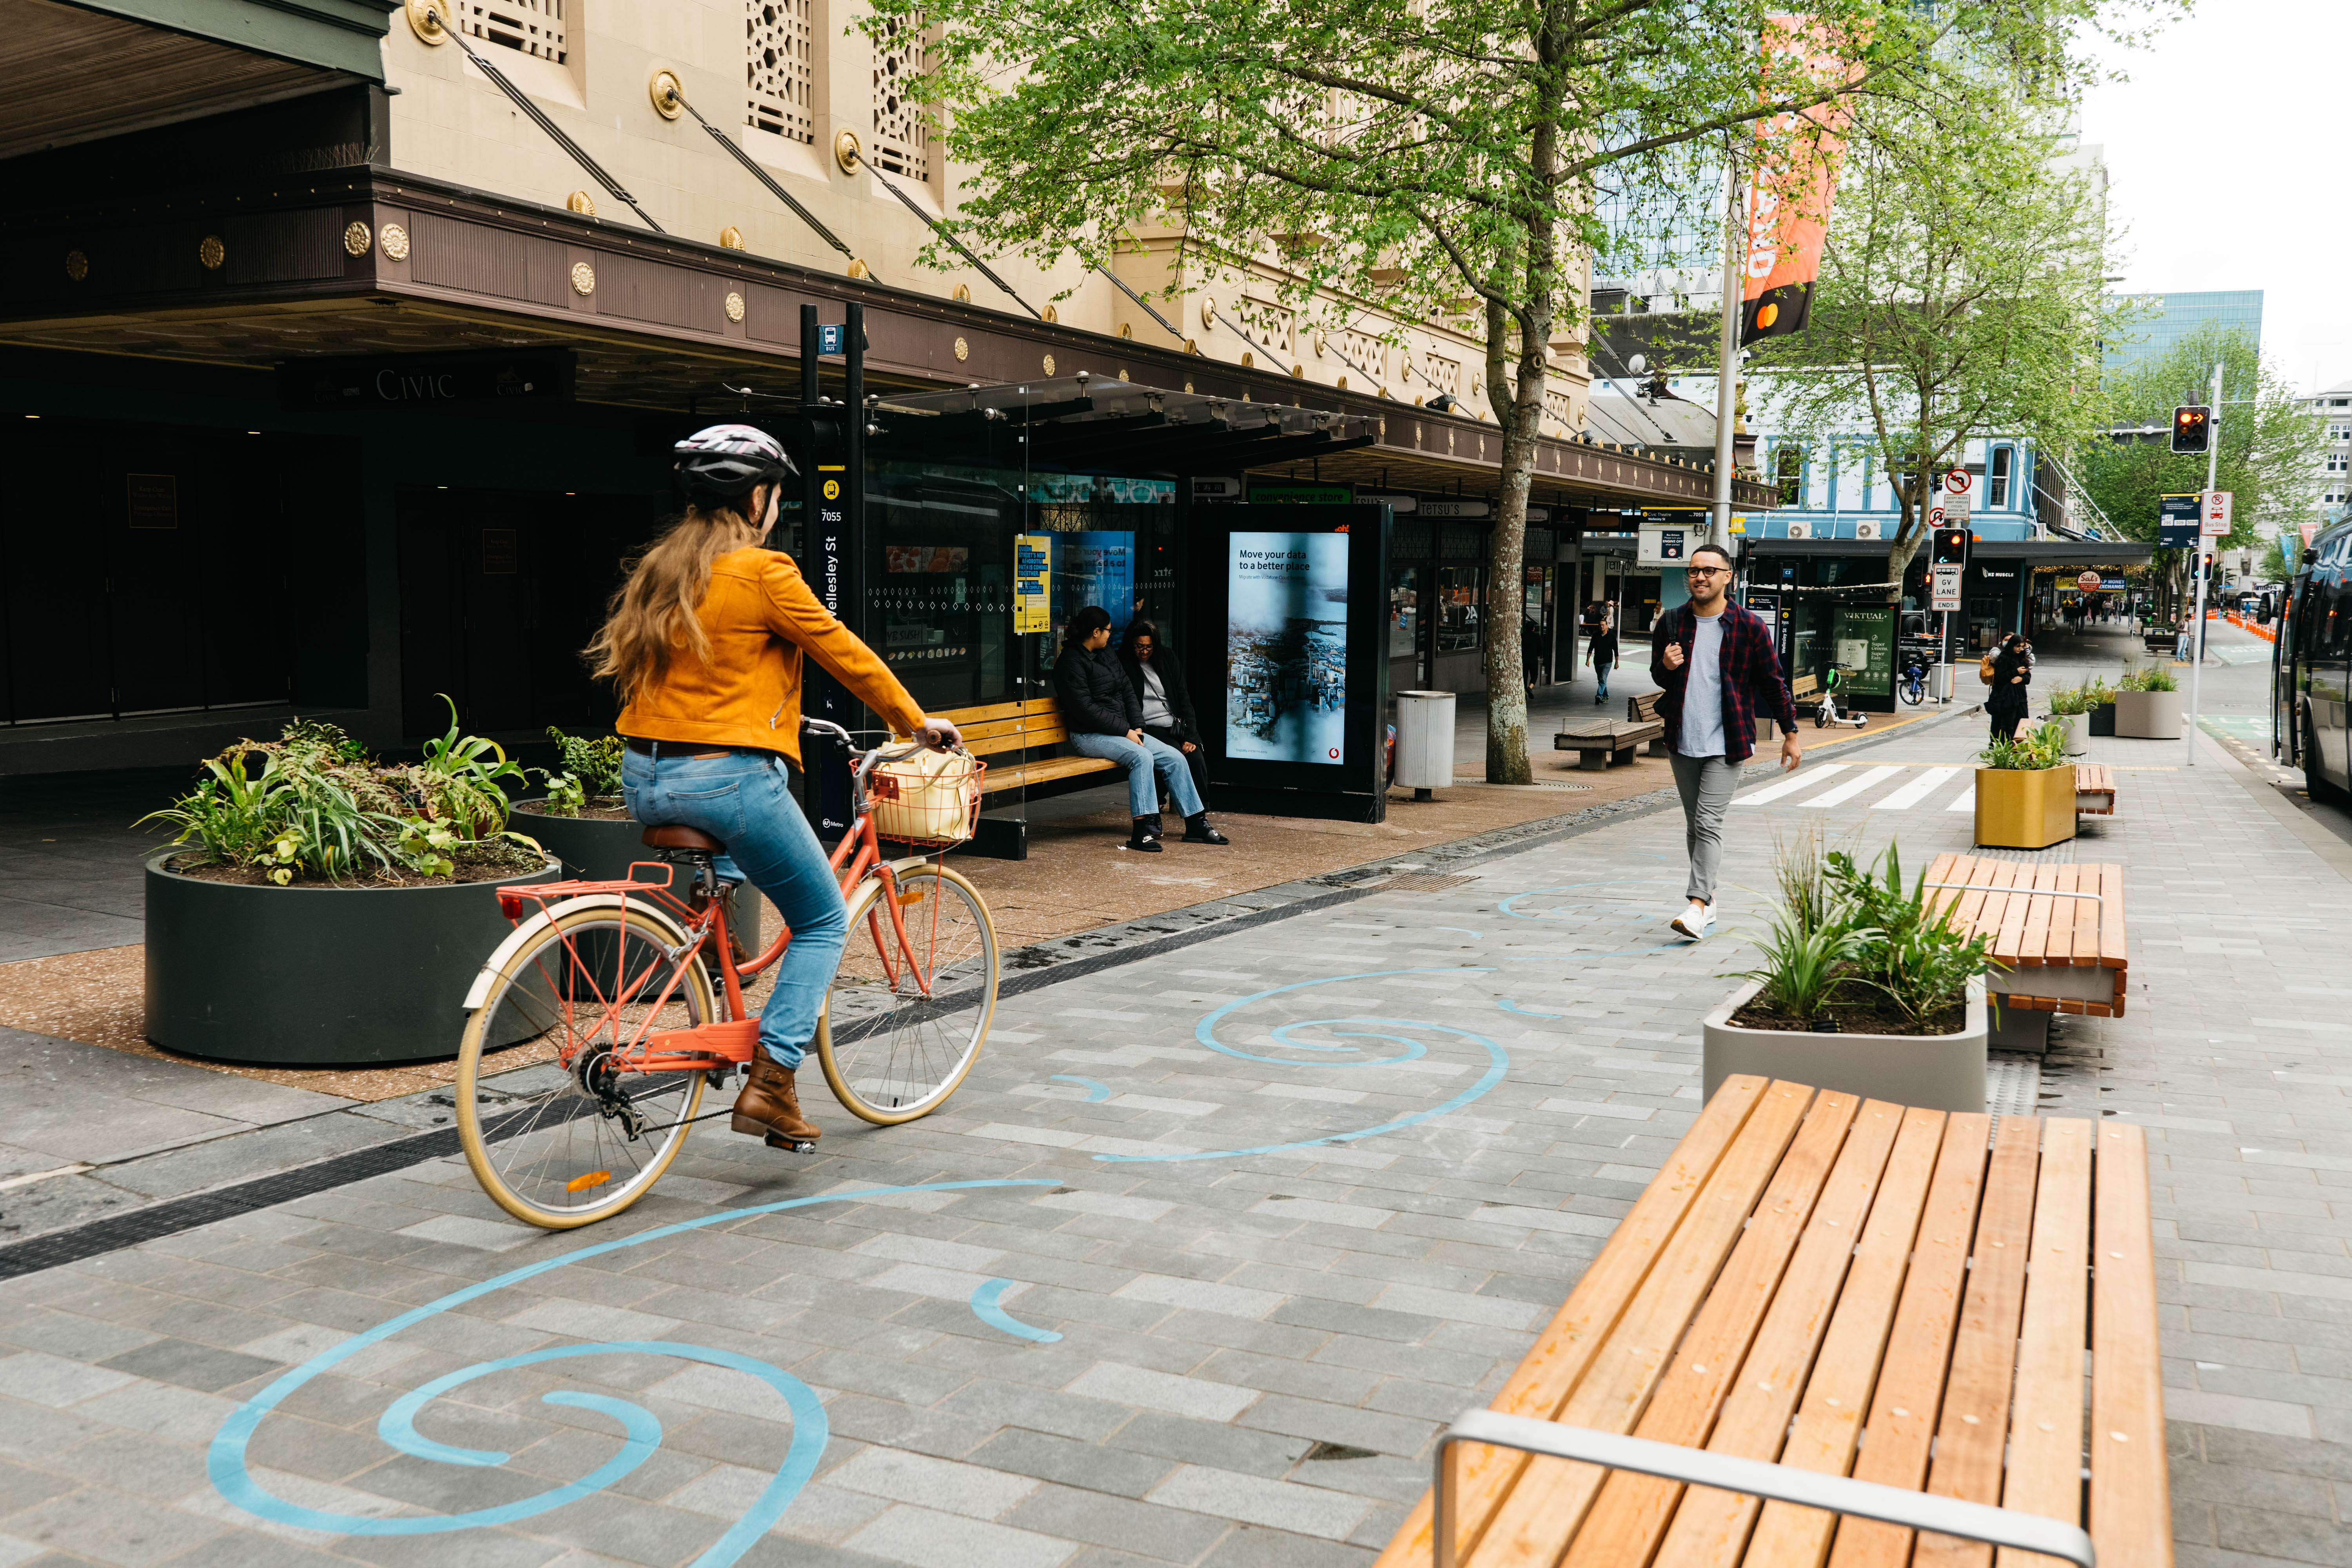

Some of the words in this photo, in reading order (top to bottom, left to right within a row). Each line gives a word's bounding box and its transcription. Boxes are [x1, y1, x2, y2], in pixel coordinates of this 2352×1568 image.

[1256, 491, 1315, 503] convenience
[1319, 492, 1343, 502] store
[822, 512, 841, 521] 7055
[826, 536, 836, 551] St
[1240, 550, 1263, 558] Move
[1265, 552, 1285, 560] your
[1287, 550, 1306, 559] data
[1258, 561, 1284, 570] better
[1286, 562, 1310, 572] place
[1607, 559, 1632, 573] remdy
